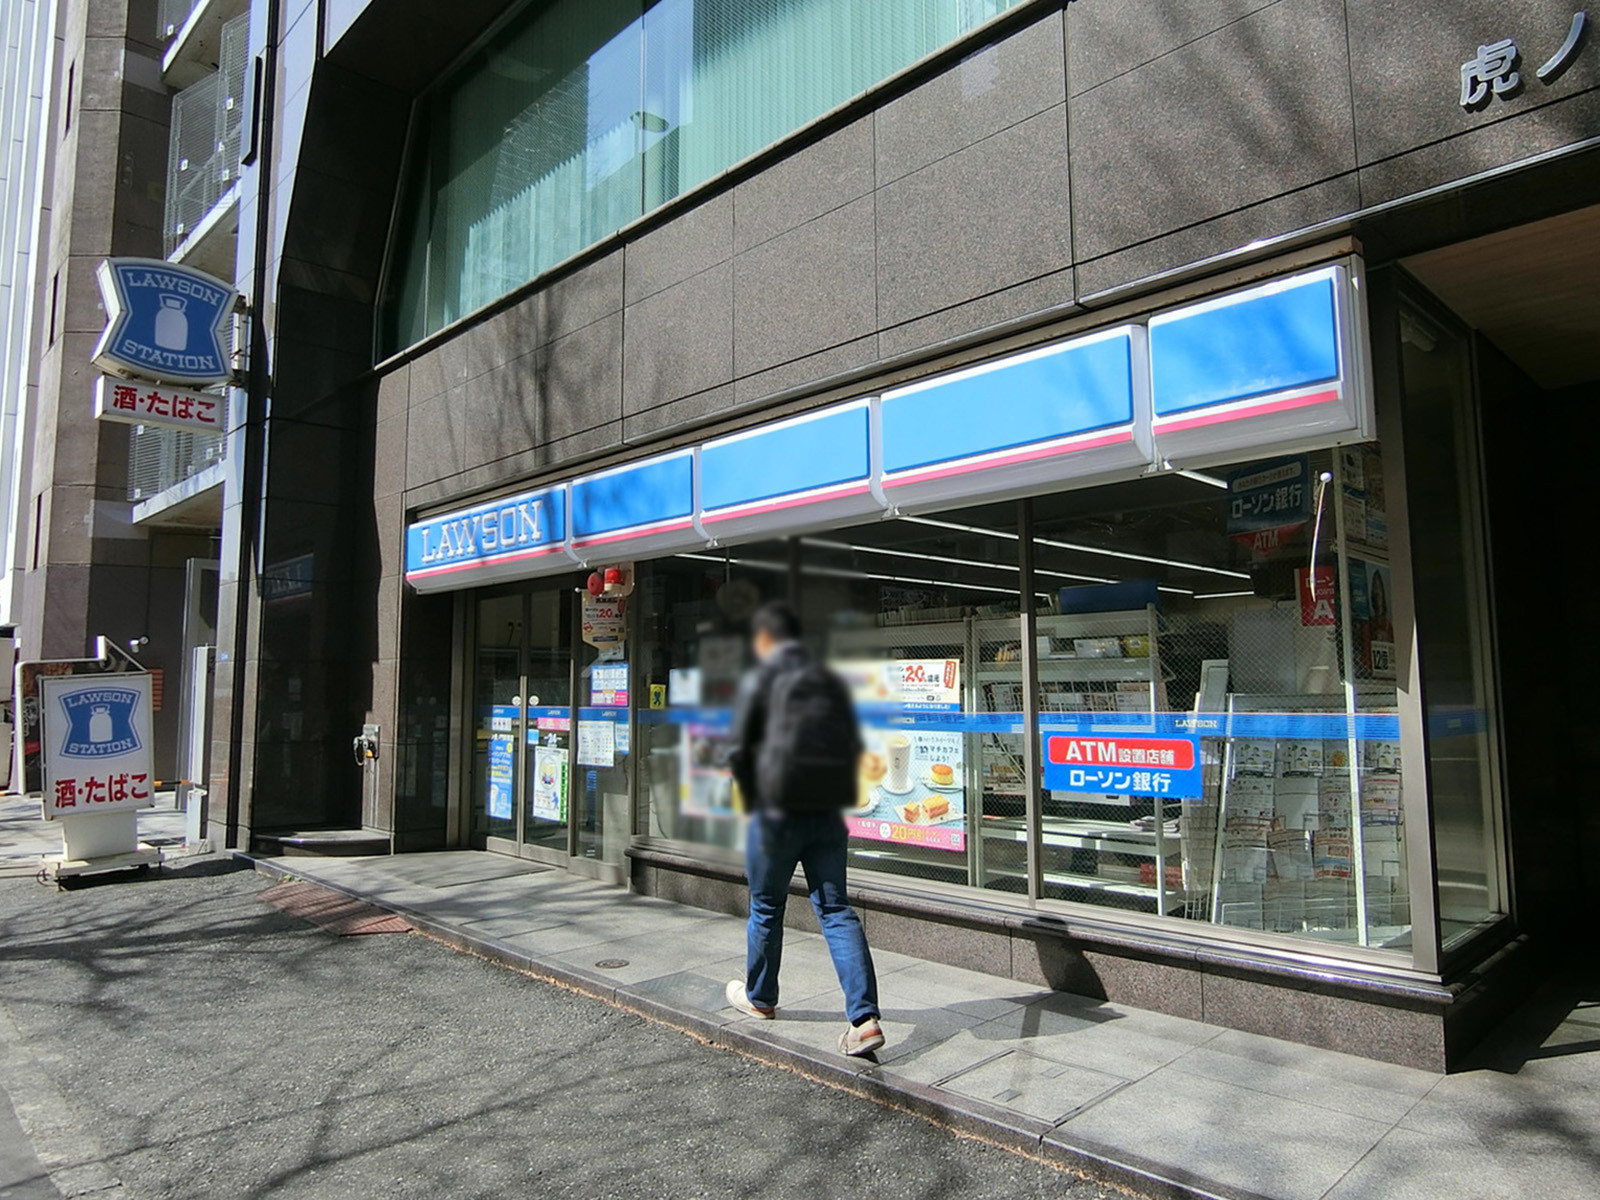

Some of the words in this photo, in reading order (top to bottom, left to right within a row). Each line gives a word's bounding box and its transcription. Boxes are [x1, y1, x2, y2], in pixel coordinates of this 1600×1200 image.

[1460, 11, 1585, 106] 虎ノ
[126, 271, 223, 306] LAWSON
[122, 339, 217, 370] STATION
[112, 385, 216, 423] 酒・たばこ
[1232, 484, 1303, 519] ローソン銀行
[421, 499, 542, 563] LAWSON
[1253, 531, 1280, 551] ATM
[1312, 599, 1335, 619] A
[68, 691, 133, 708] LAWSON
[1174, 719, 1218, 728] LAWSON
[68, 739, 133, 755] STATION
[1065, 740, 1175, 766] ATM設置店舗
[55, 772, 149, 808] 酒・たばこ
[1069, 769, 1172, 793] ローソン銀行
